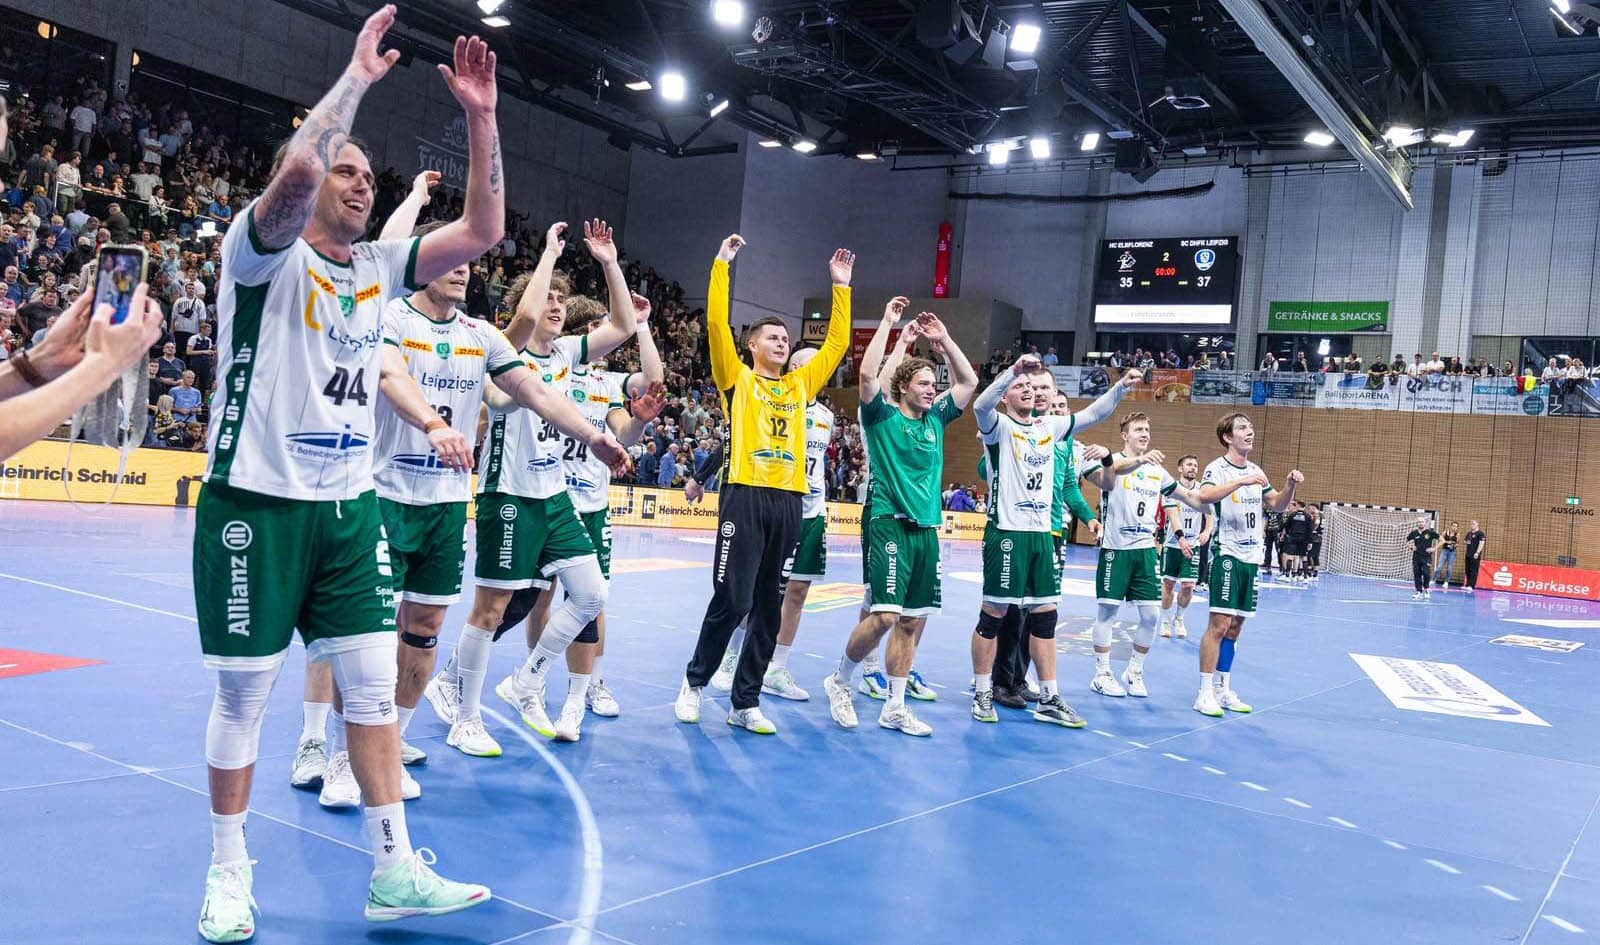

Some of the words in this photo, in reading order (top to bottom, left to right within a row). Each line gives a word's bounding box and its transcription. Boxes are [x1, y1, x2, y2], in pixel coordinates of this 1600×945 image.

[1163, 252, 1170, 262] 2
[1155, 268, 1176, 276] 60:00
[1197, 276, 1211, 287] 37
[1120, 277, 1133, 288] 35
[1275, 311, 1329, 321] GETRÄNKE
[1330, 312, 1338, 321] &
[1340, 312, 1382, 321] SNACKS
[808, 324, 825, 335] WC
[323, 366, 368, 407] 44
[538, 417, 560, 442] 34
[770, 417, 788, 438] 12
[563, 437, 587, 462] 24
[805, 455, 817, 476] 7
[77, 468, 147, 485] Schmid
[1027, 471, 1043, 491] 32
[659, 504, 692, 516] Heinrich
[1137, 501, 1146, 517] 6
[1550, 506, 1594, 516] AUSGANG
[1184, 518, 1193, 529] 11
[1245, 512, 1256, 529] 18
[499, 523, 514, 570] Allianz
[717, 539, 731, 583] Allianz
[886, 556, 897, 596] Allianz
[1000, 553, 1011, 590] Allianz
[1103, 562, 1113, 592] Allianz
[227, 554, 250, 637] Allianz
[1221, 571, 1231, 602] Allianz
[1518, 578, 1590, 595] Sparkasse
[381, 818, 394, 843] CRAFT
